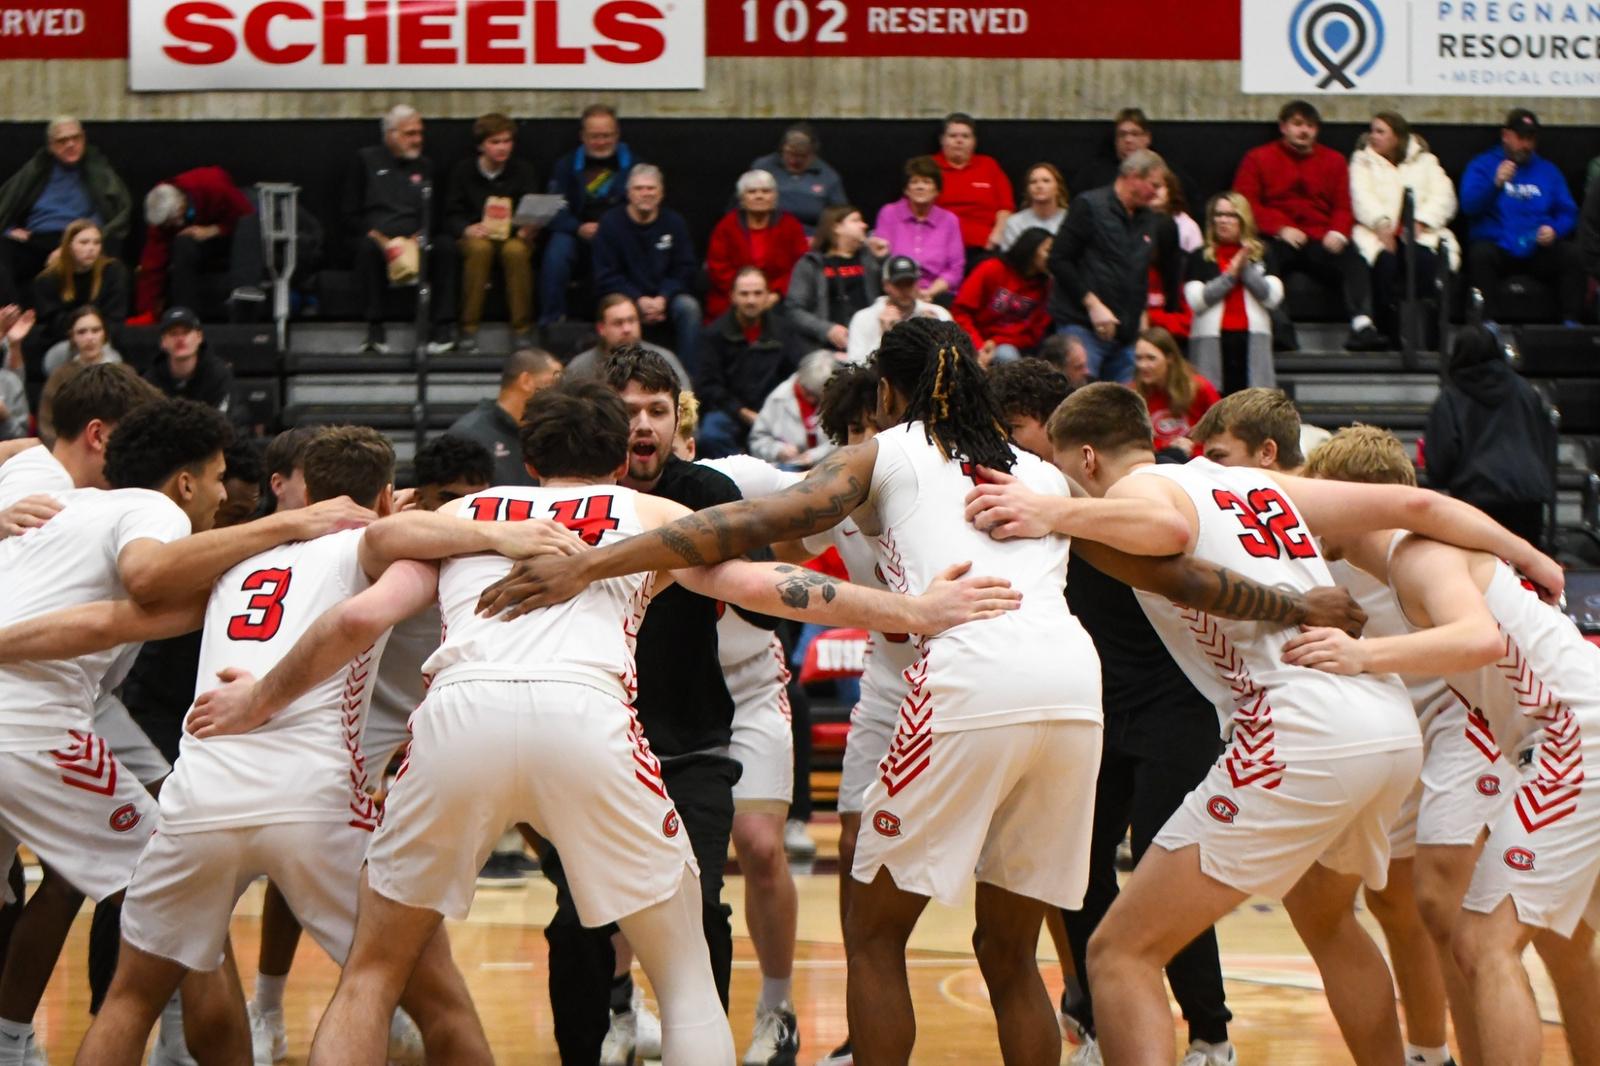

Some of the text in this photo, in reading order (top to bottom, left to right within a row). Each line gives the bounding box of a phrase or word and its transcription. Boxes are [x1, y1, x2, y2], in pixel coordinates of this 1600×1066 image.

[0, 9, 86, 36] RVED
[162, 1, 666, 65] SCHEELS
[741, 0, 1029, 43] 102 RESERVED
[1451, 69, 1543, 86] MEDICAL
[1212, 487, 1317, 560] 32
[227, 566, 292, 642] 3
